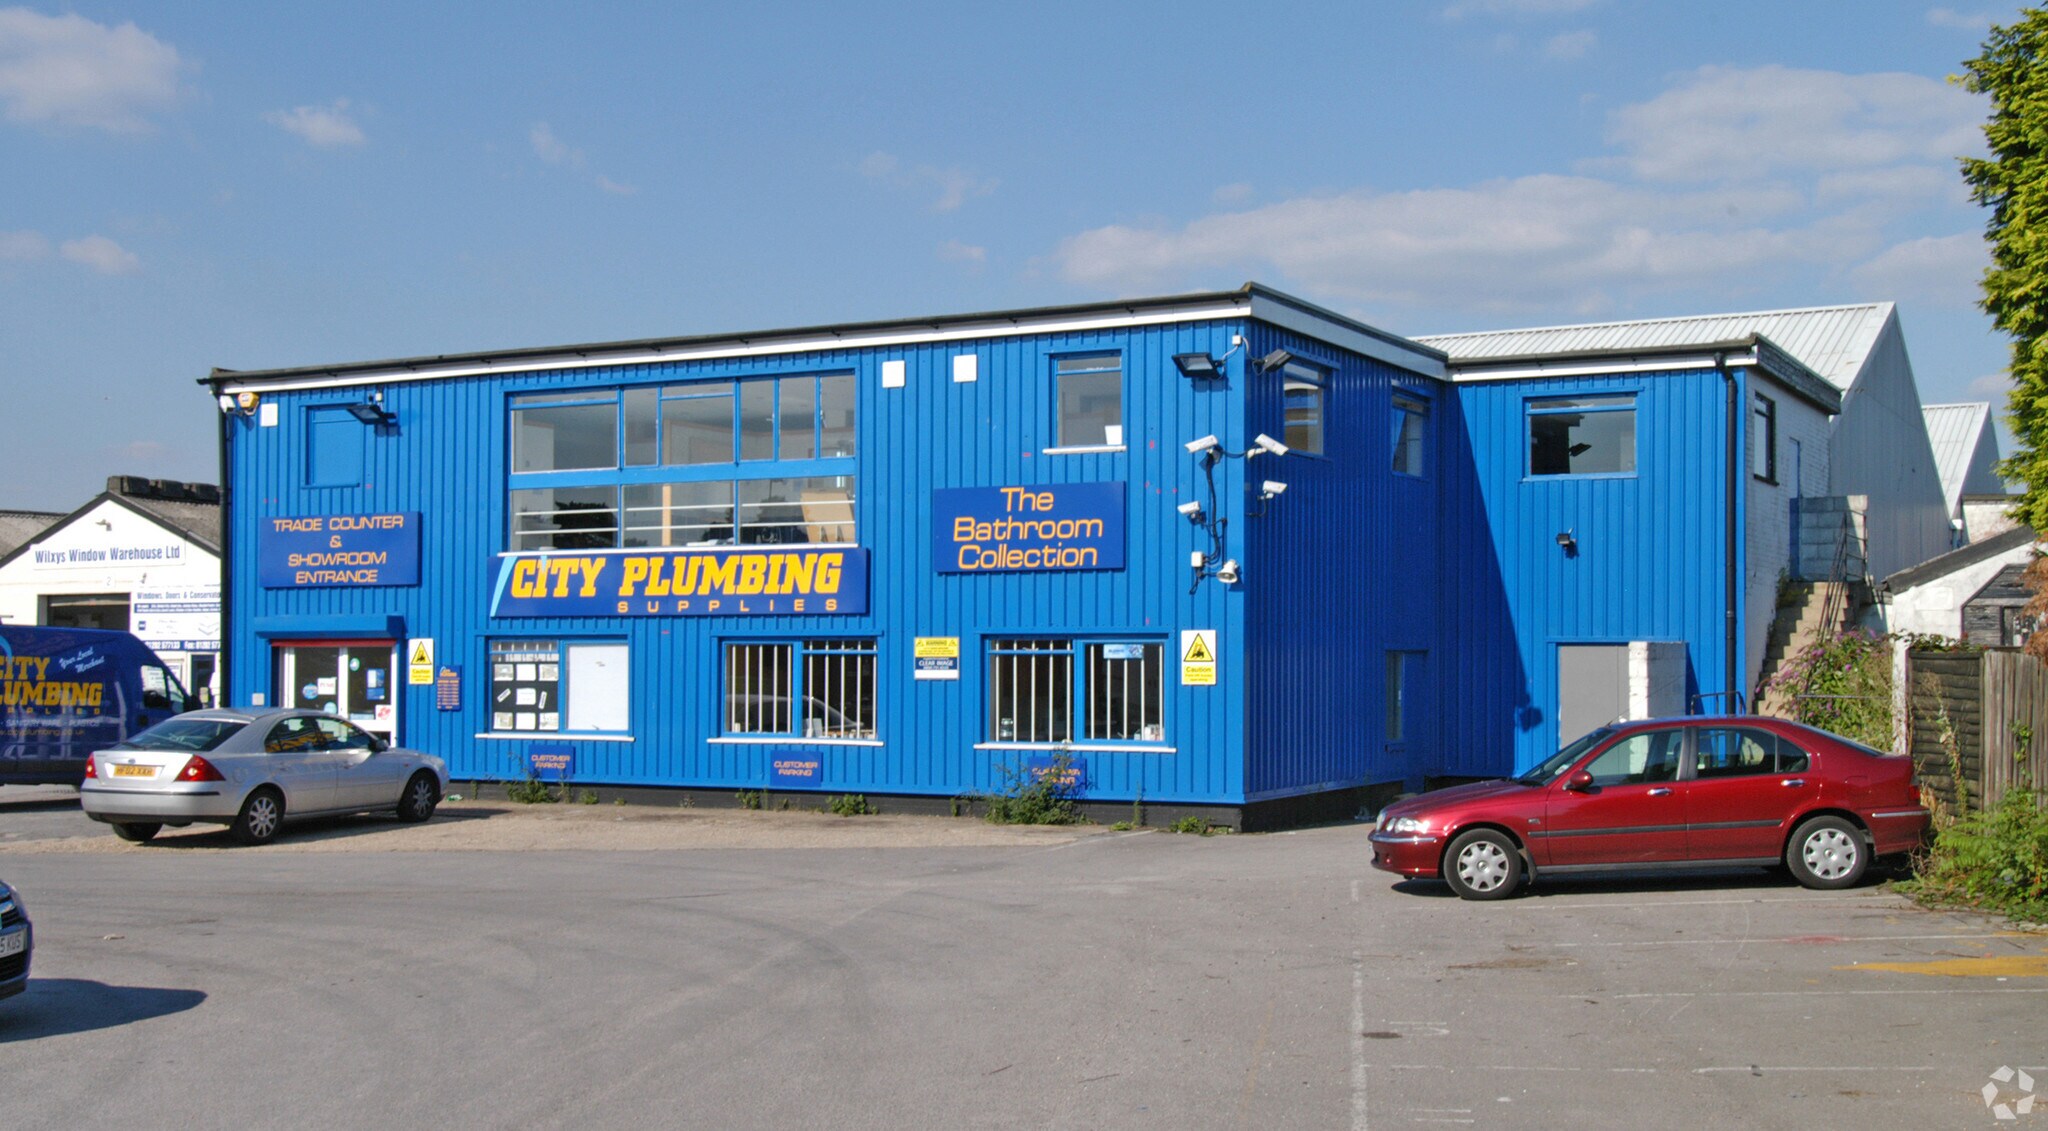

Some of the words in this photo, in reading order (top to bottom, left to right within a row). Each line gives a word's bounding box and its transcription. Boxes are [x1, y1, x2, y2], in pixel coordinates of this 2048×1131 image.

[1000, 487, 1054, 512] The
[273, 518, 323, 532] TRADE
[329, 515, 404, 531] COUNTER
[953, 516, 1103, 542] Bathroom
[330, 535, 342, 548] &
[35, 551, 66, 565] Wilxys
[69, 549, 106, 562] Window
[110, 547, 162, 560] Warehouse
[166, 545, 180, 559] Ltd
[288, 552, 387, 567] SHOWROOM
[958, 543, 1098, 570] Collection
[296, 569, 378, 584] ENTRANCE
[511, 556, 606, 598] CITY
[618, 553, 844, 597] PLUMBING
[166, 591, 180, 599] Doors
[617, 599, 838, 613] SUPPLIES
[0, 681, 103, 706] UMBING
[774, 760, 818, 768] CUSTOMER
